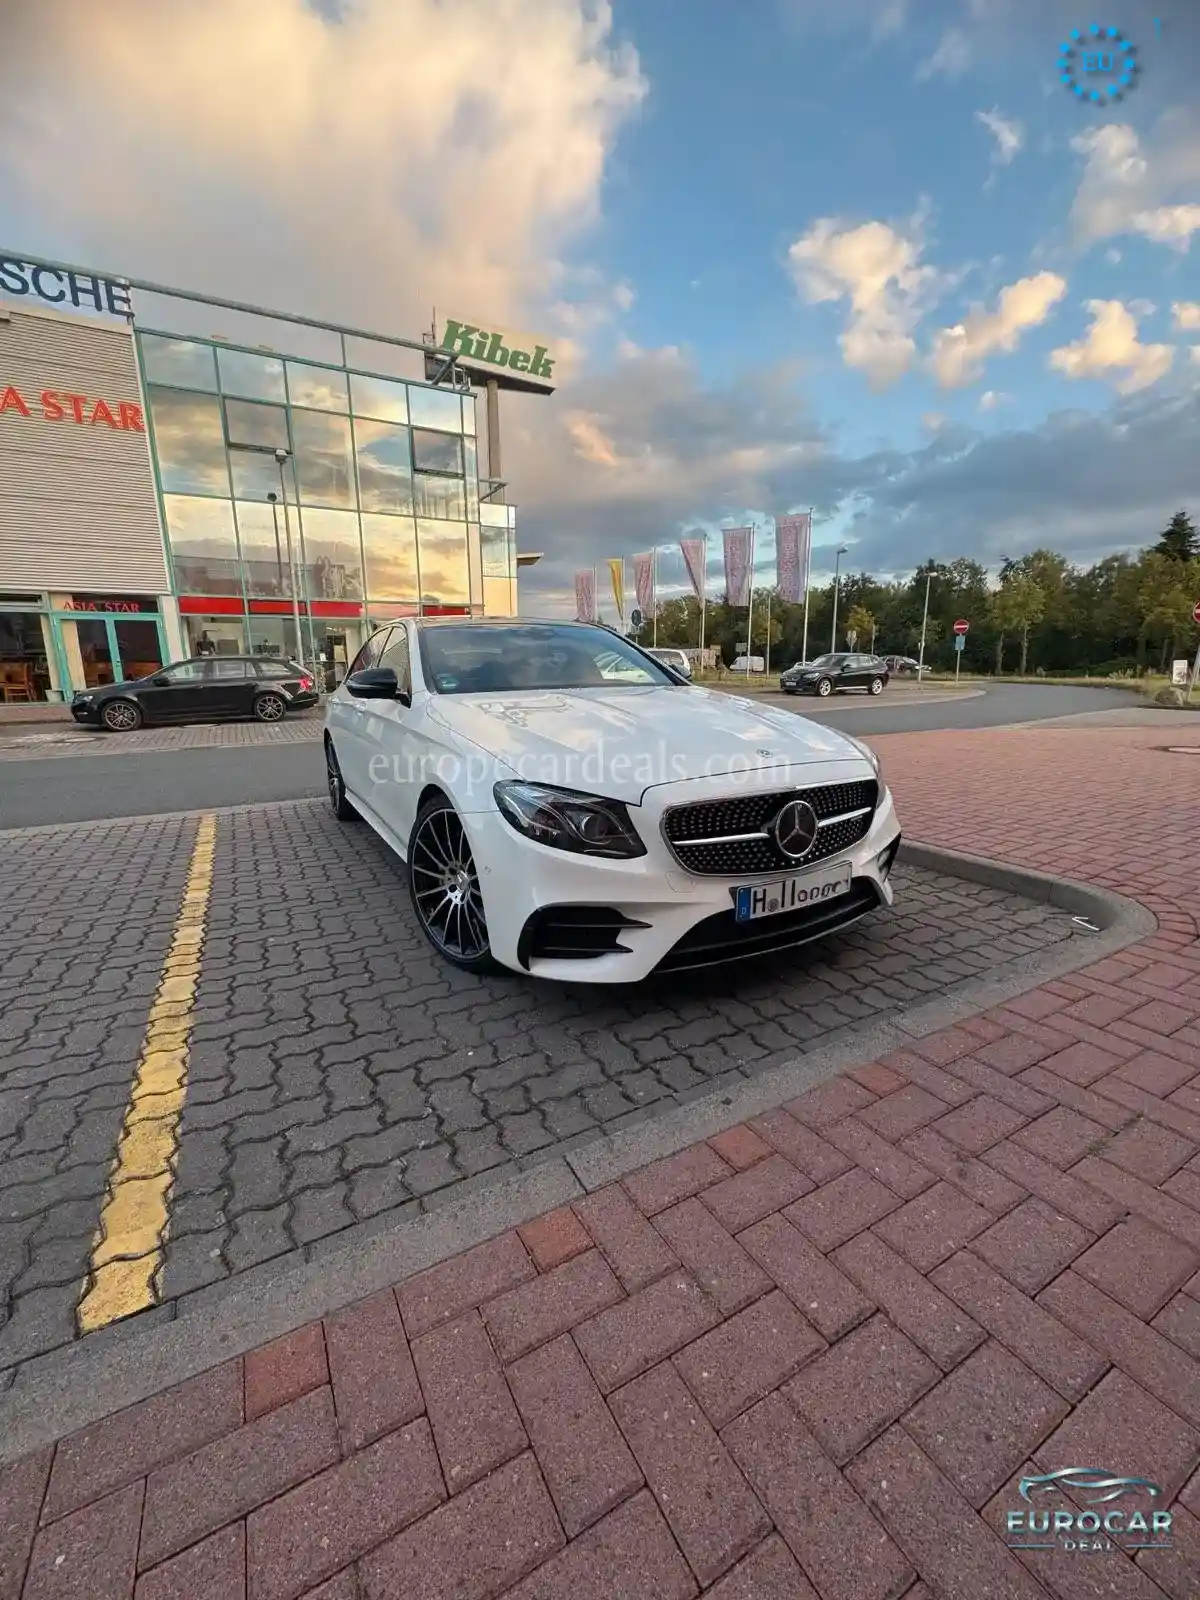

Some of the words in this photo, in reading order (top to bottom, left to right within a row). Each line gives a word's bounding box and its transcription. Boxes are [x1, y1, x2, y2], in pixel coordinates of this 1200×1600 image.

[0, 258, 135, 318] SCHE
[441, 319, 556, 379] Kibek
[0, 385, 31, 417] A
[40, 389, 146, 433] STAR
[64, 600, 98, 612] ASIA
[104, 601, 140, 613] STAR
